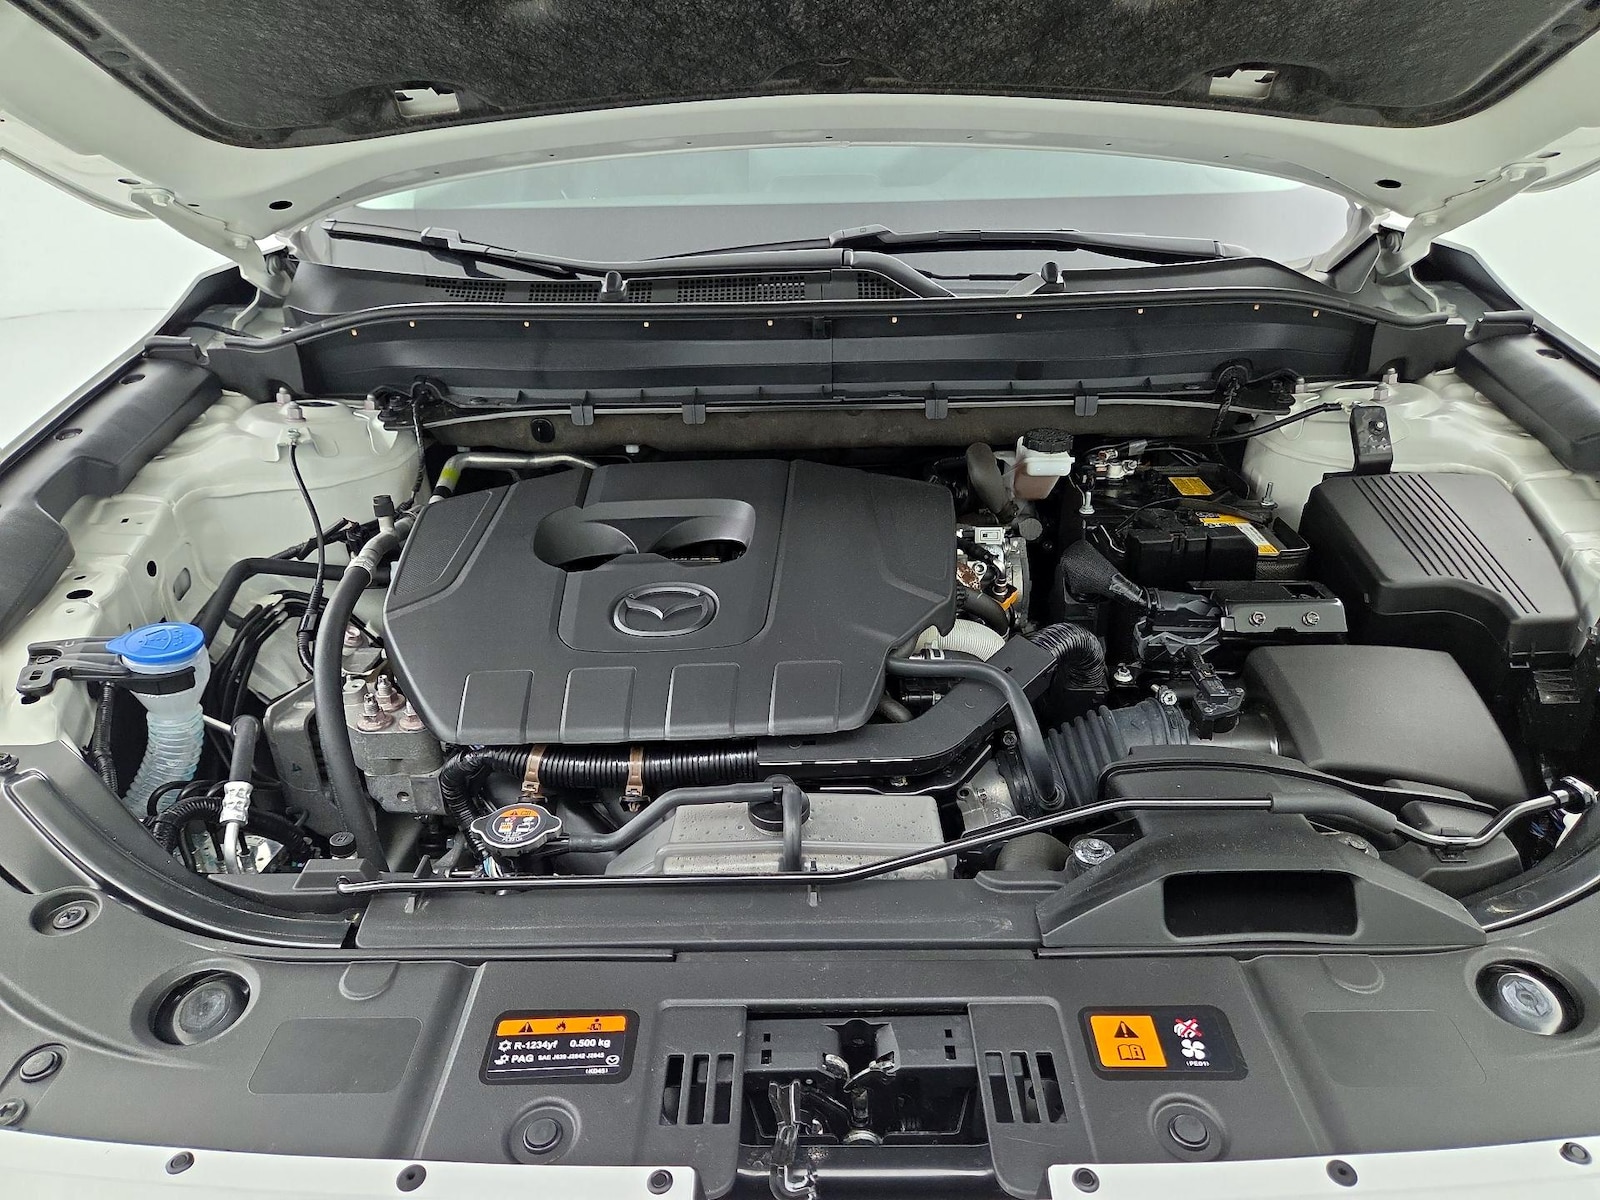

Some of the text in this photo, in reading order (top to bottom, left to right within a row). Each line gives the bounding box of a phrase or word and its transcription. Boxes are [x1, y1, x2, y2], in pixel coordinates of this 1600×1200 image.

[514, 1038, 611, 1051] R-1234yf 0.500 kg
[511, 1054, 534, 1064] PAG
